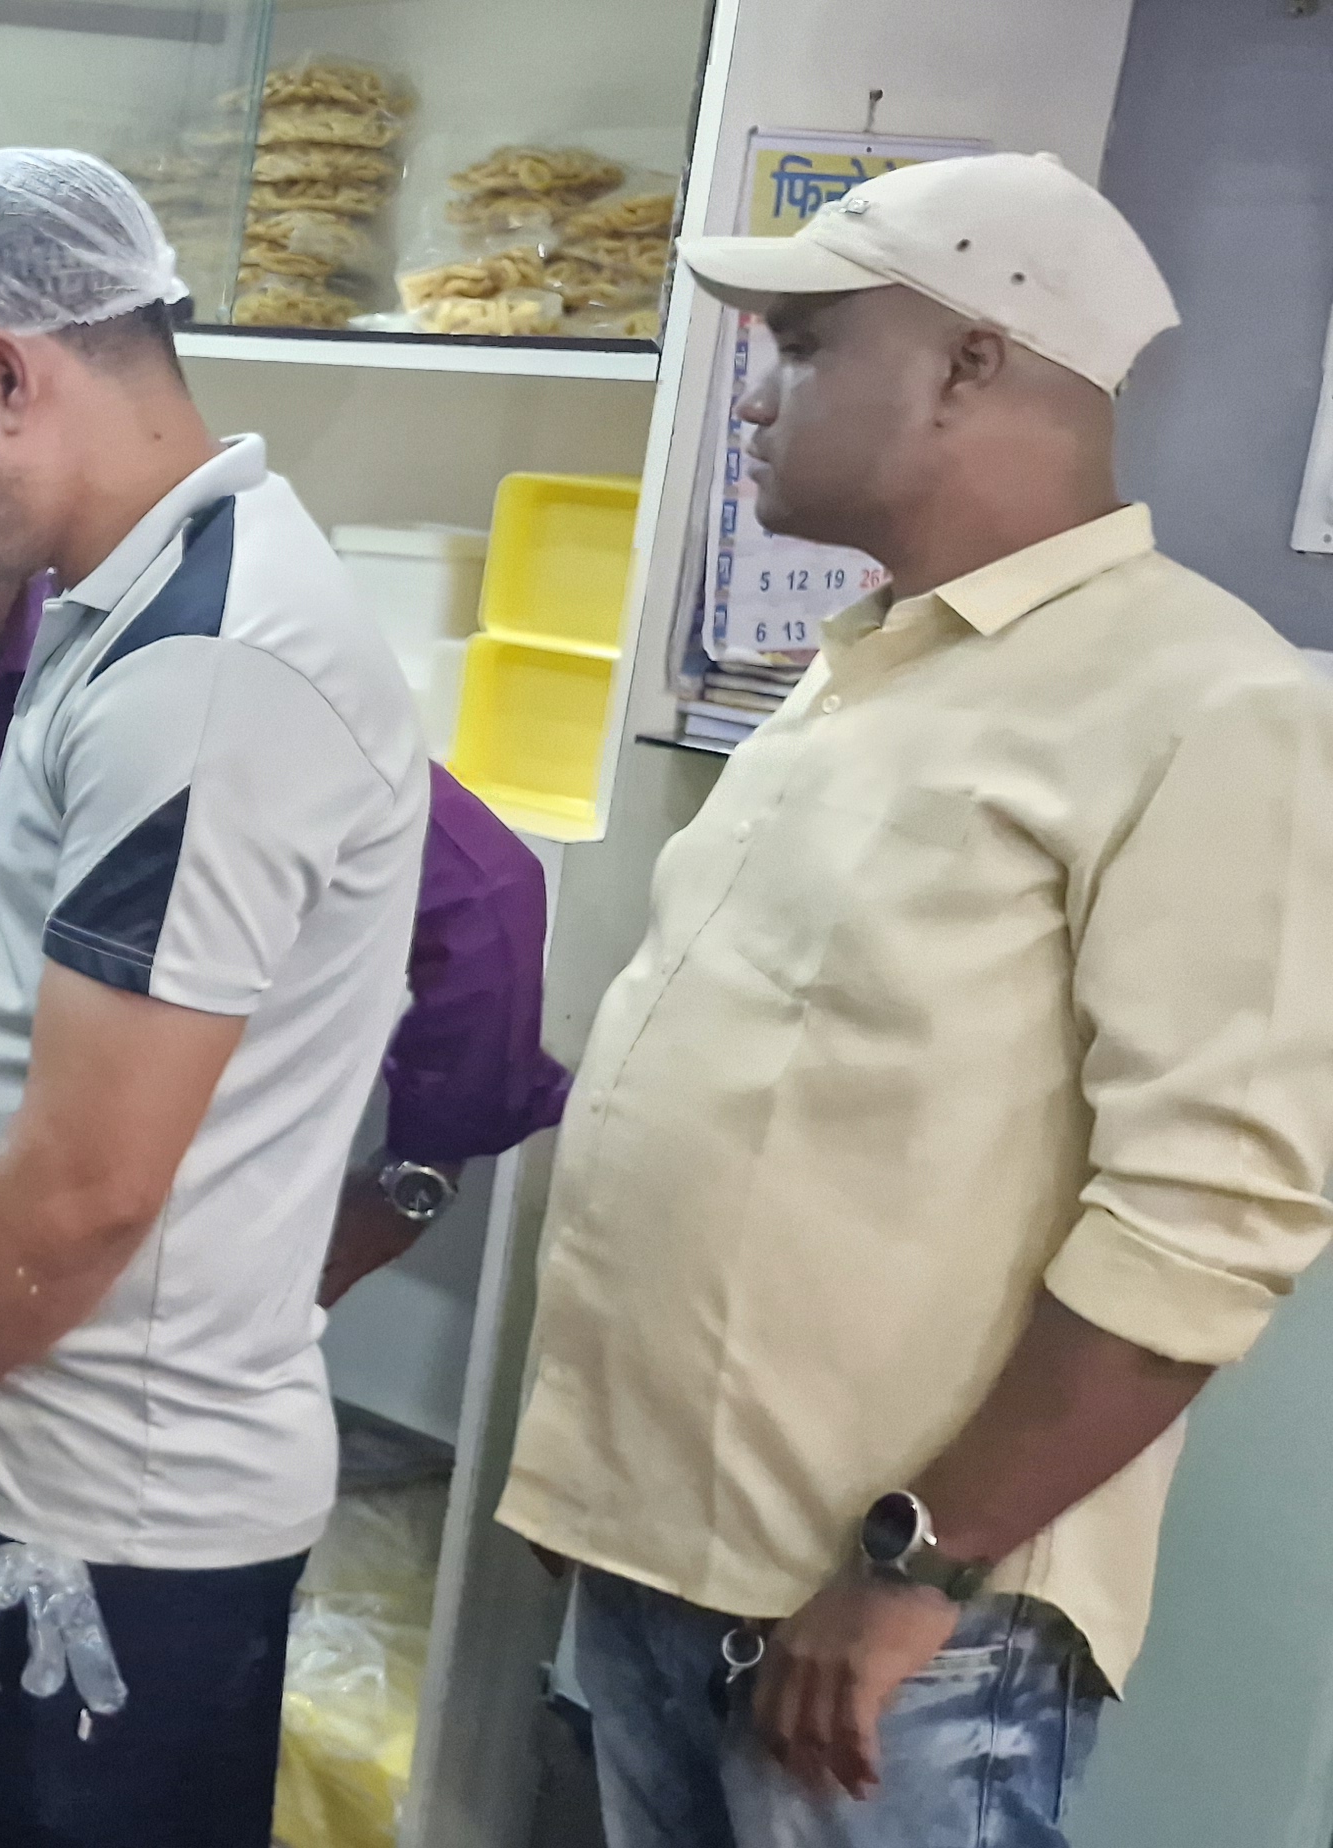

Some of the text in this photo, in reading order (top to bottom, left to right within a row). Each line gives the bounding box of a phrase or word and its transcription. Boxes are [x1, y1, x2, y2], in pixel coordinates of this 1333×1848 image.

[759, 569, 880, 592] 5 12 19 26
[755, 620, 806, 643] 6 13
